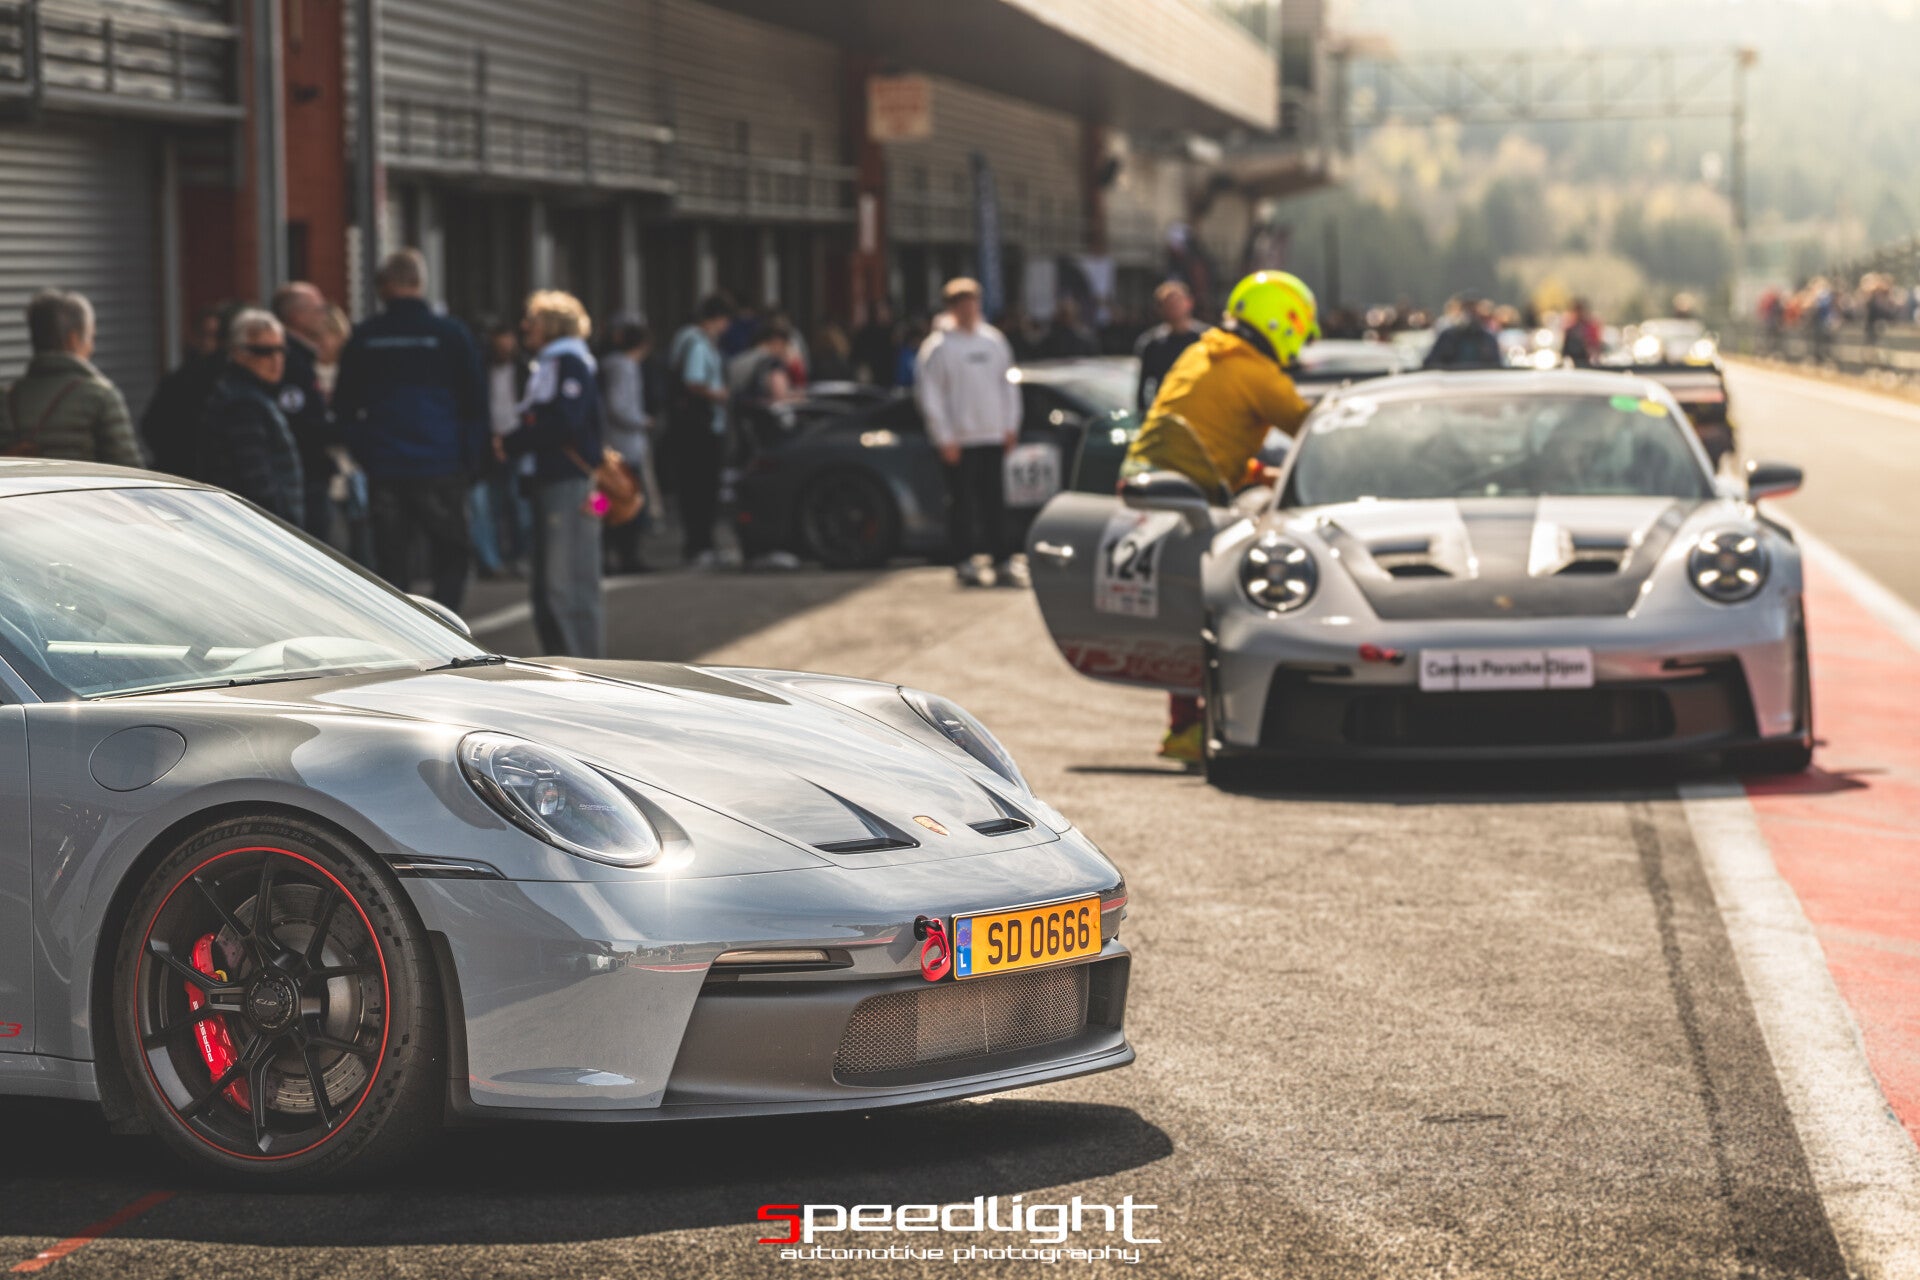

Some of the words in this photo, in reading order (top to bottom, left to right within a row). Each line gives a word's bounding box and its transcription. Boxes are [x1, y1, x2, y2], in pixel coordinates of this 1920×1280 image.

[1106, 537, 1155, 580] 124
[1426, 661, 1477, 677] Centre
[1480, 659, 1542, 675] Porsche
[1545, 658, 1588, 679] Dijon
[176, 824, 252, 860] MICHELIN
[988, 919, 1022, 965] SD
[1030, 907, 1090, 959] 0666
[960, 953, 967, 968] L
[0, 1021, 23, 1038] 3
[193, 1000, 214, 1063] PORSCE
